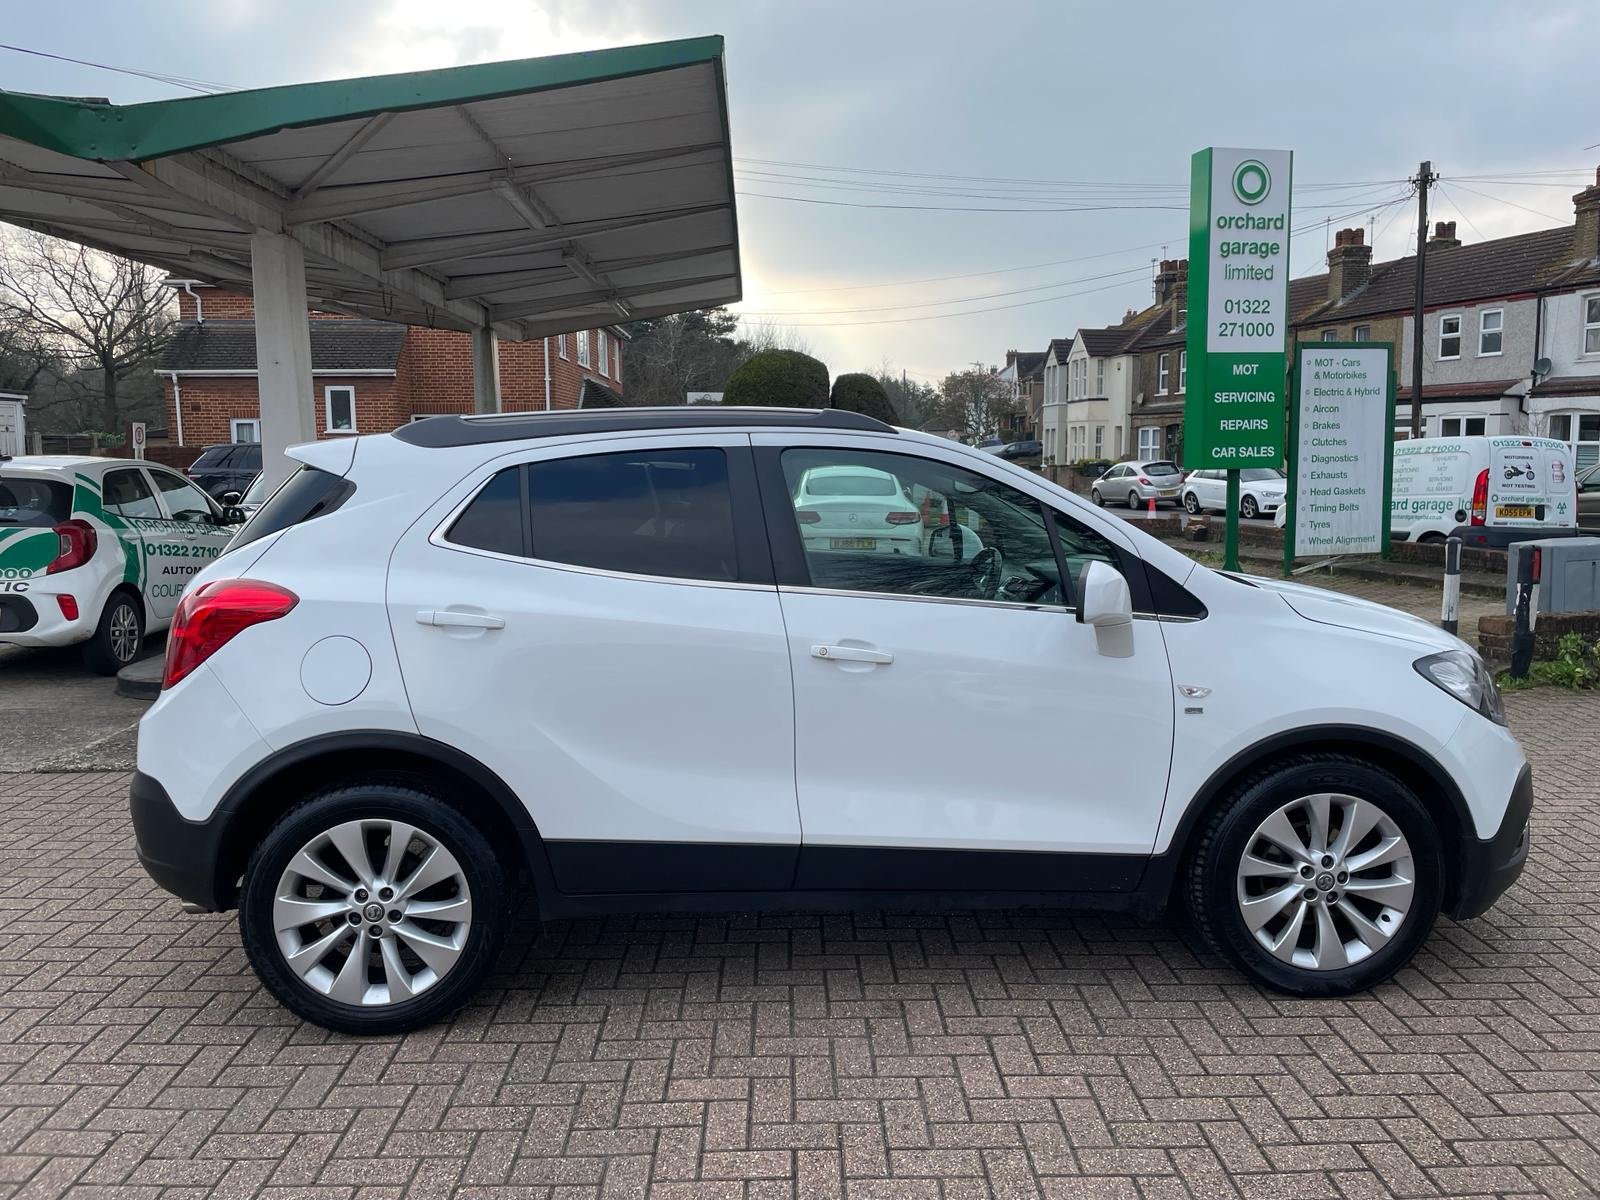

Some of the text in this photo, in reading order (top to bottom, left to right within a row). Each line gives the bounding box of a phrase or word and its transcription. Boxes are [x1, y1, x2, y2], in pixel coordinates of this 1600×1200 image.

[1216, 212, 1284, 229] orchard
[1220, 239, 1280, 258] garage
[1224, 264, 1274, 281] limited
[1224, 299, 1270, 314] 01322
[1218, 322, 1274, 337] 271000
[1314, 359, 1334, 367] MOT
[1341, 358, 1361, 367] Cars
[1232, 364, 1259, 375] MOT
[1314, 371, 1367, 380] & Motorbikes
[1214, 391, 1275, 403] SERVICING
[1313, 387, 1381, 397] Electric & Hybrid
[1312, 405, 1340, 413] Aircon
[1220, 419, 1268, 430] REPAIRS
[1312, 421, 1341, 430] Brakes
[1311, 438, 1347, 446] Clutches
[1532, 440, 1564, 449] 271000
[1212, 446, 1275, 458] CAR SALES
[1311, 454, 1359, 464] Diagnostics
[1310, 471, 1348, 480] Exhausts
[1310, 487, 1366, 496] Head Gaskets
[1309, 503, 1359, 514] Timing Belts
[1412, 500, 1453, 513] garage
[138, 518, 195, 534] ORCHARD
[1309, 521, 1331, 531] Tyres
[1308, 535, 1375, 546] Wheel Alignment
[146, 543, 189, 557] 01322
